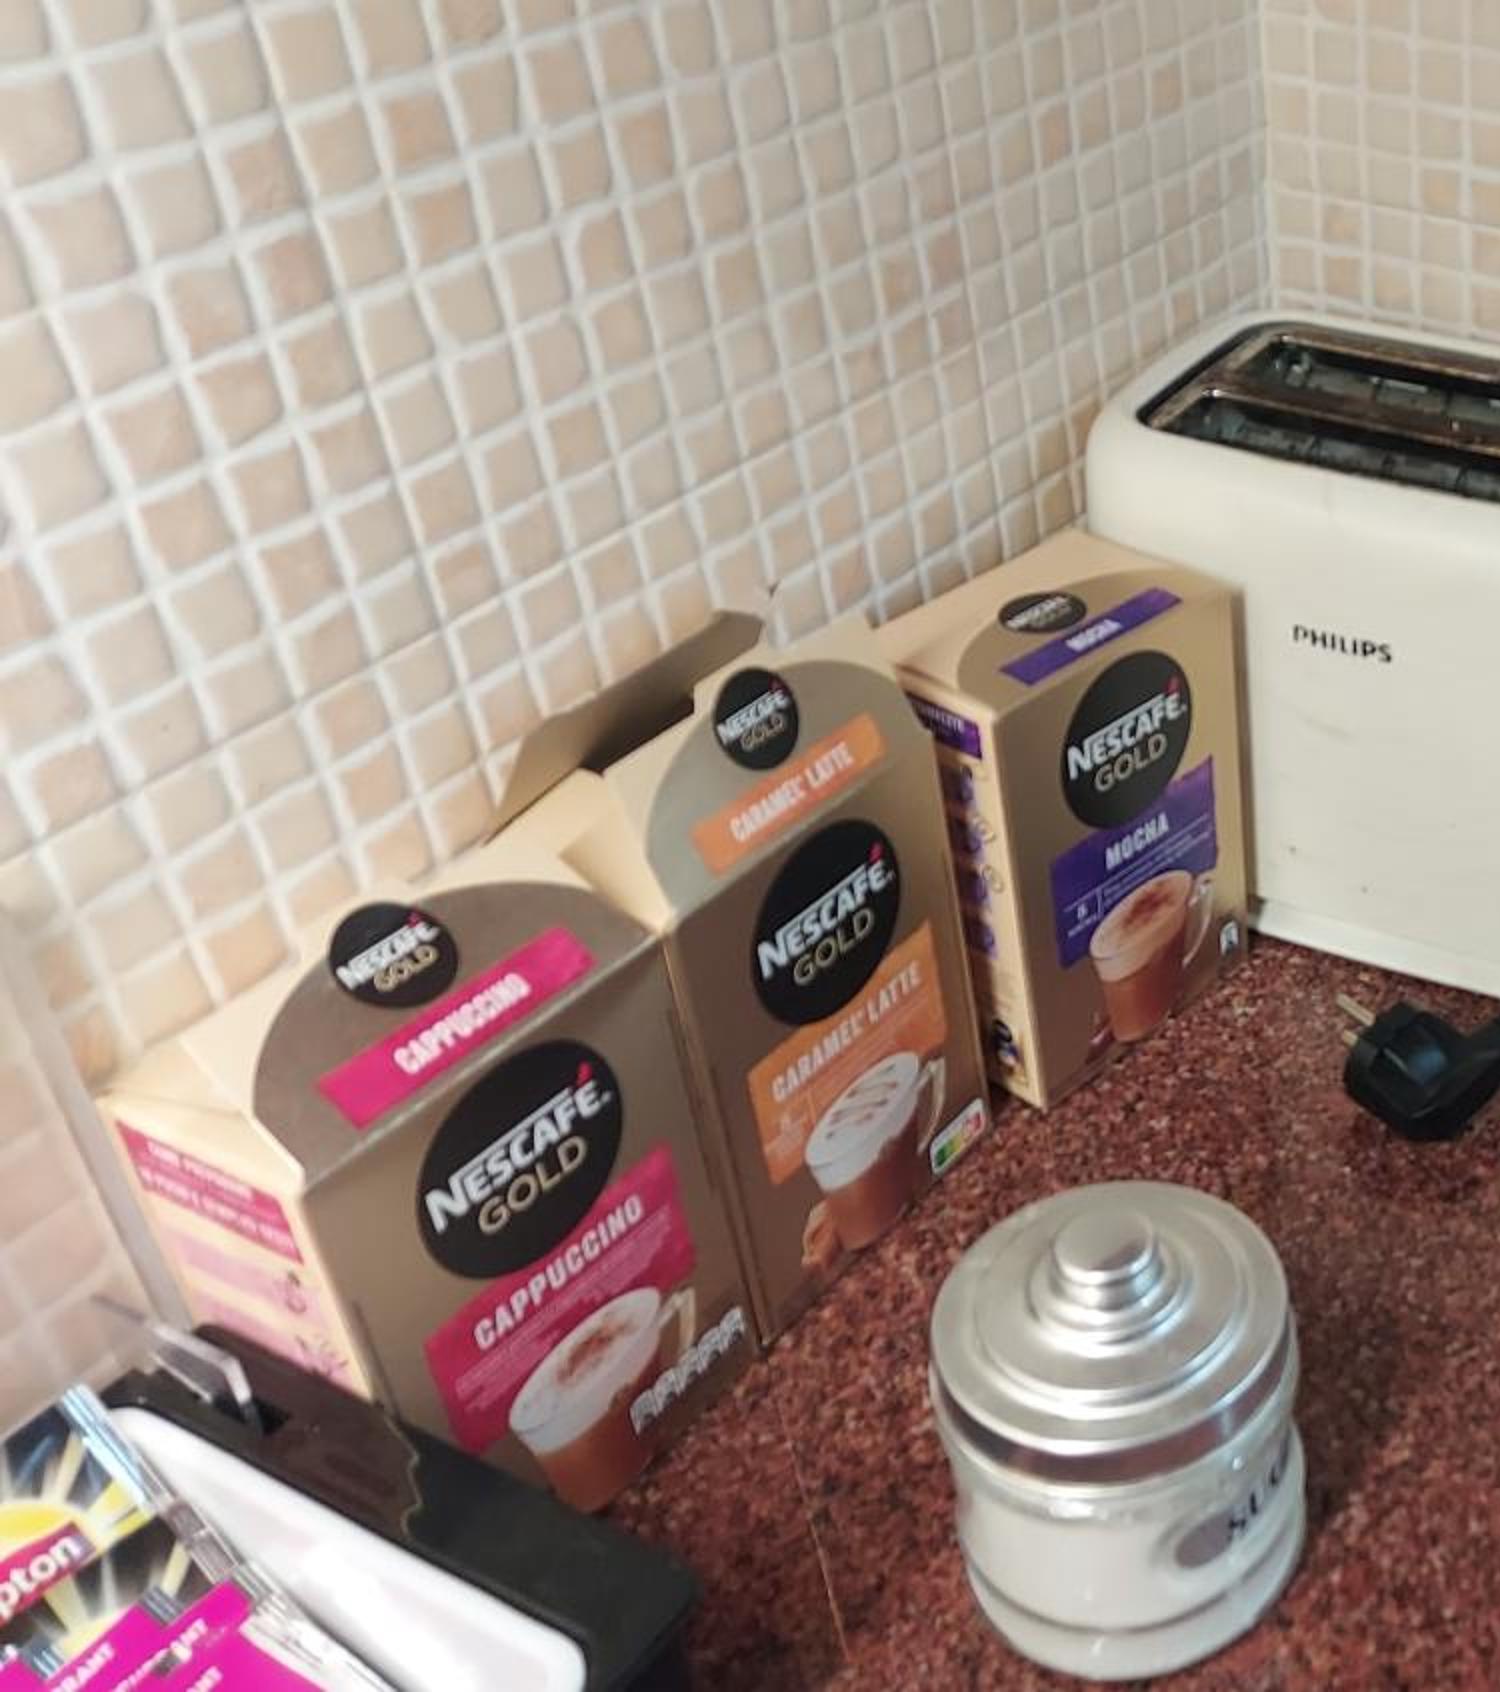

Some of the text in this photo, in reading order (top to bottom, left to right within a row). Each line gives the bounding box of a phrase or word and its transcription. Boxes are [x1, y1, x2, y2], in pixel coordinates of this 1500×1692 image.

[1292, 623, 1392, 663] PHILIPS
[1094, 732, 1169, 792] GOLD
[1105, 812, 1169, 870] MOCHA
[374, 944, 438, 993] GOLD
[793, 905, 876, 987] GOLD
[393, 972, 532, 1075] CAPPUCCINO
[865, 959, 923, 1025] LATTE
[478, 1135, 588, 1235] GOLD
[473, 1194, 644, 1351] CAPPUCCINO
